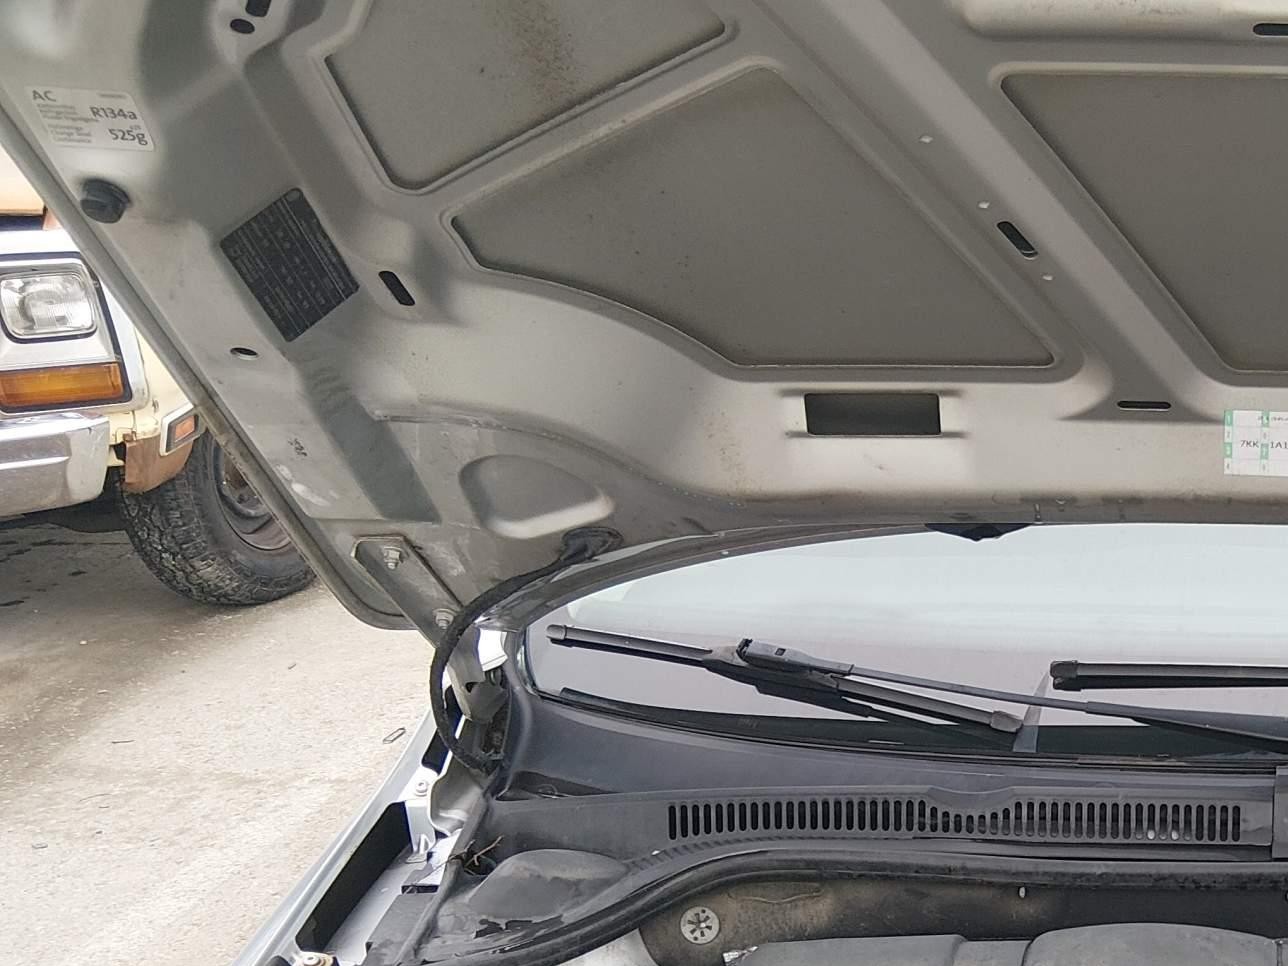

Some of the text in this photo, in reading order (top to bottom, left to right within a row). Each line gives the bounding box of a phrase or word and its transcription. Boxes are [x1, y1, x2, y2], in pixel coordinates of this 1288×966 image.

[32, 89, 57, 103] AC
[89, 106, 138, 120] R134a
[108, 127, 149, 146] 525g
[1240, 439, 1260, 449] 7KK
